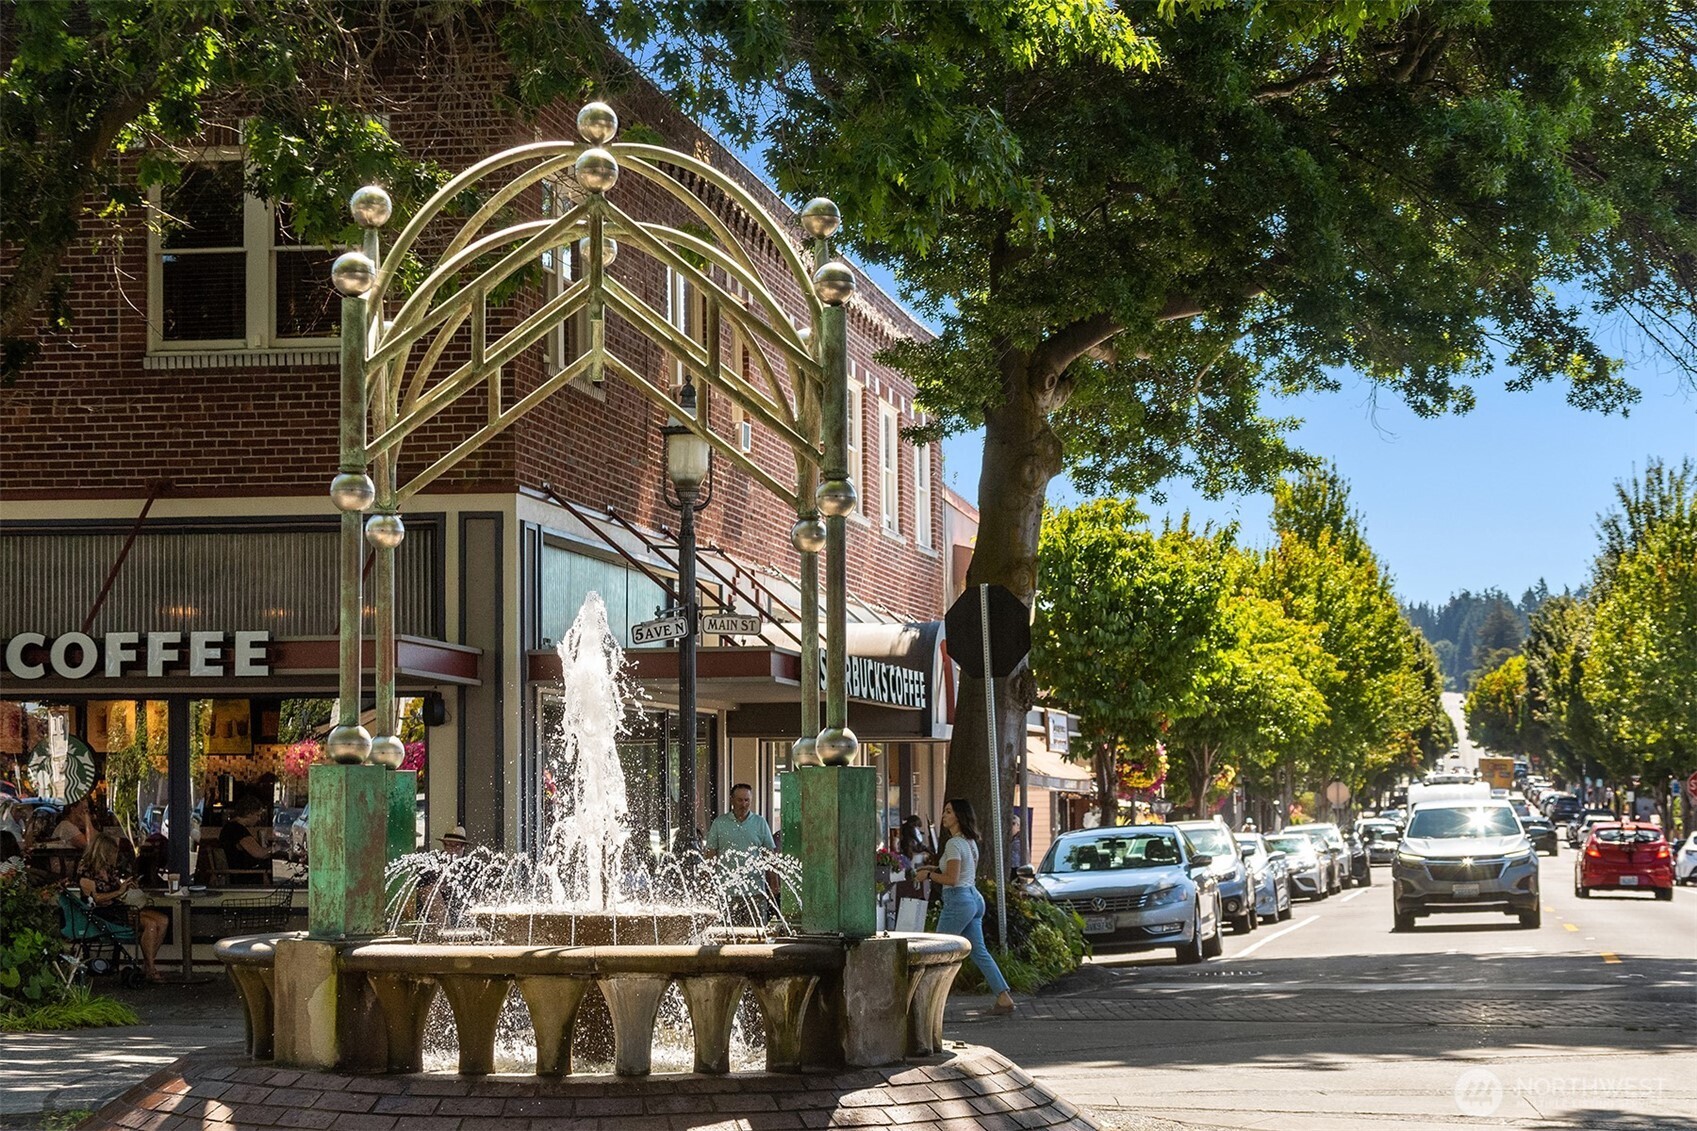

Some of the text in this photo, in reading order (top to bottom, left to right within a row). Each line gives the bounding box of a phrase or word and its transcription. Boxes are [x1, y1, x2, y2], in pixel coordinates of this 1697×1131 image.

[635, 622, 685, 641] 5 AVE N
[707, 619, 757, 632] MAIN ST
[6, 631, 269, 680] COFFEE
[820, 648, 927, 709] SRBUCKS COFFEE
